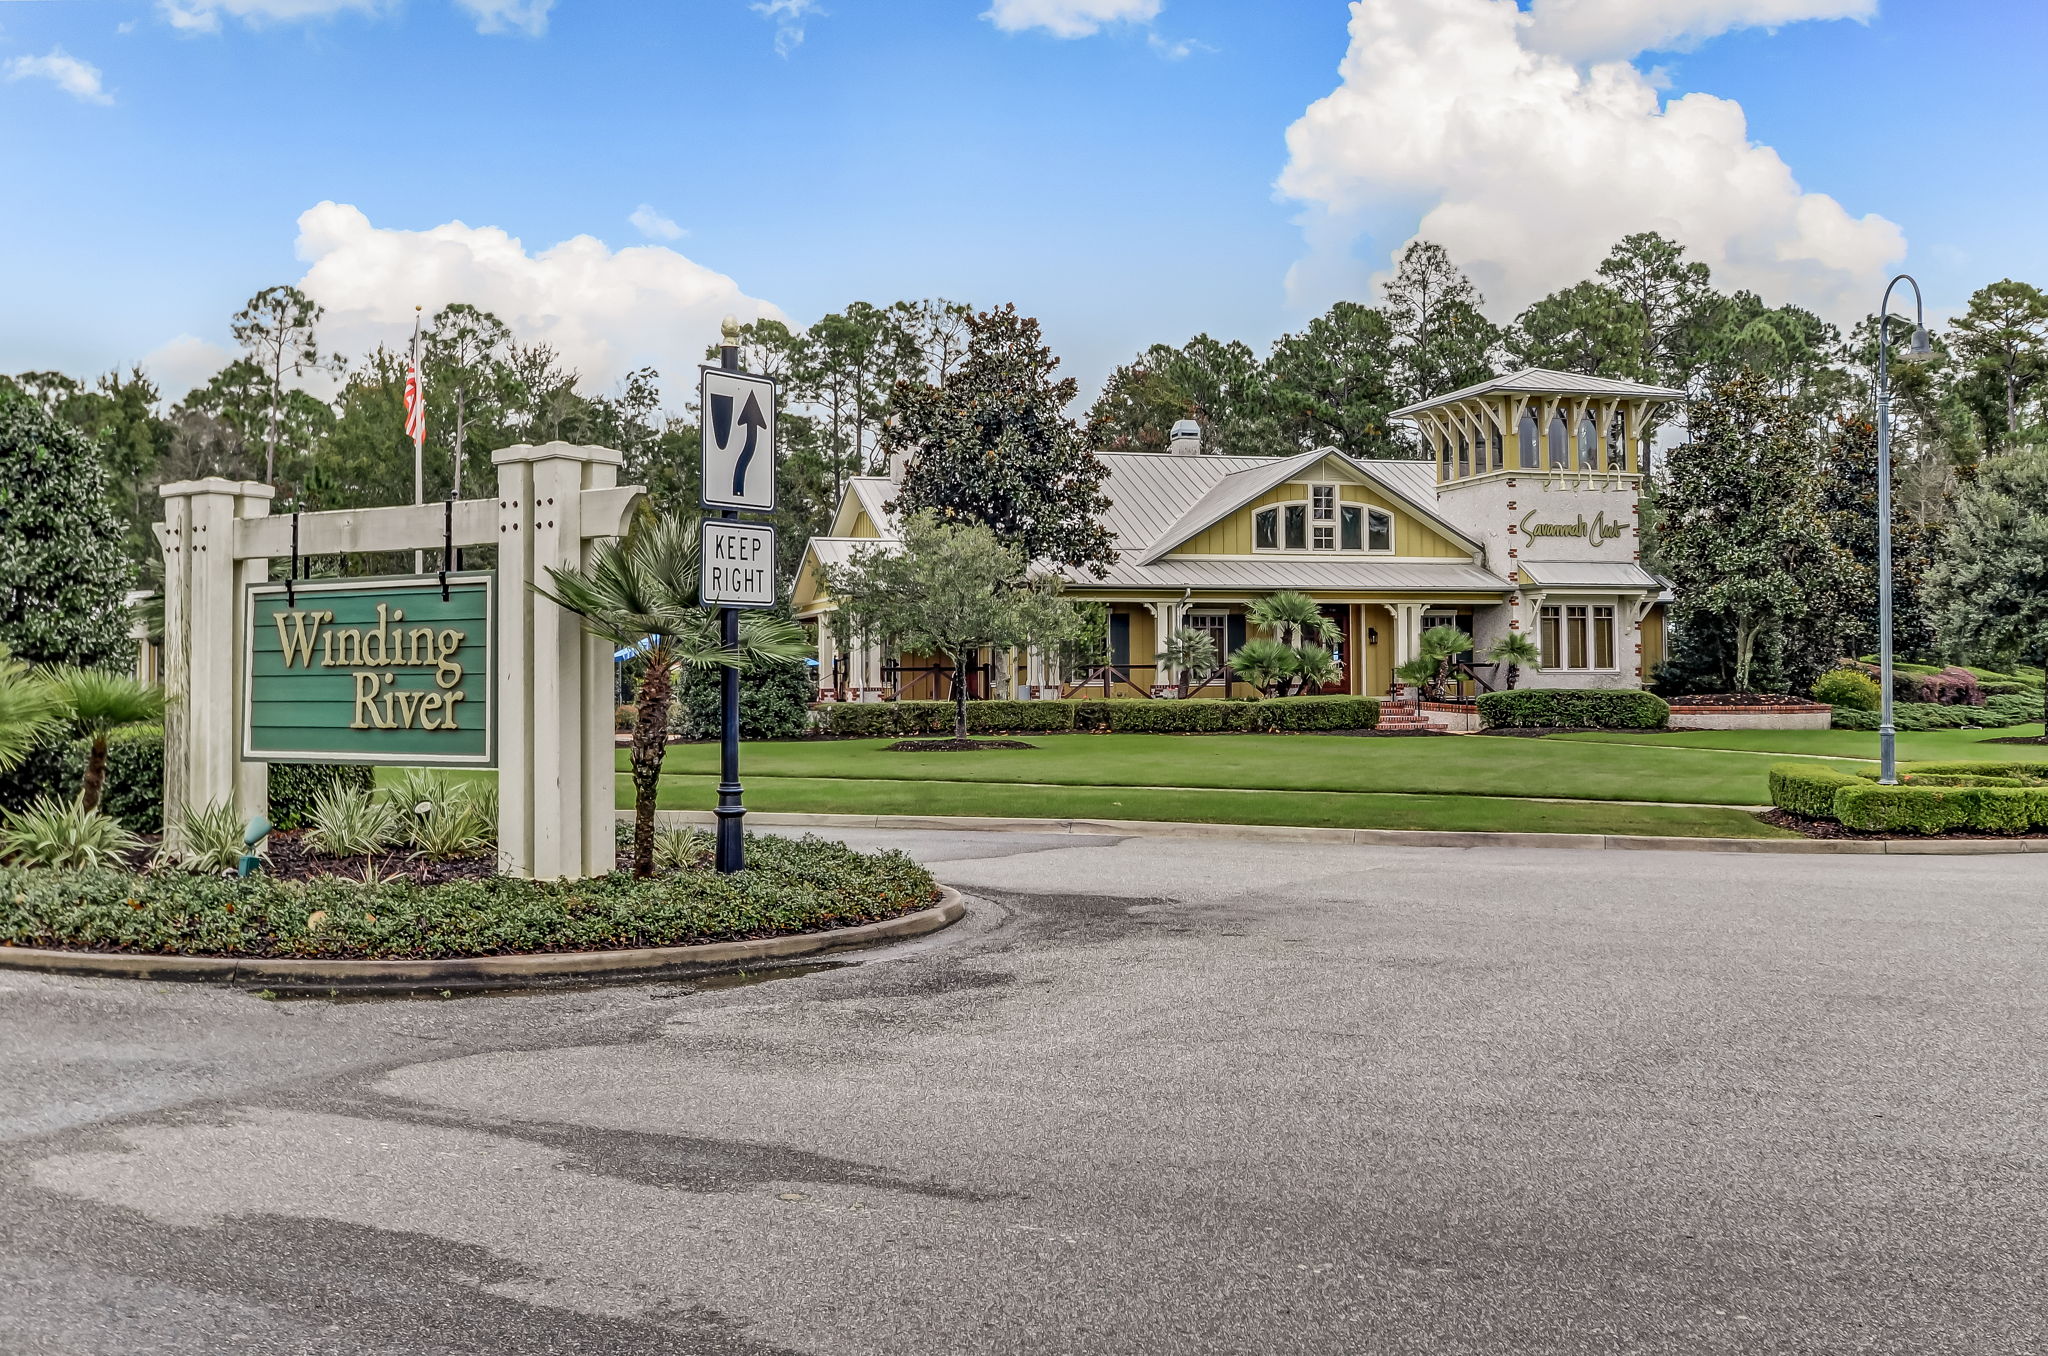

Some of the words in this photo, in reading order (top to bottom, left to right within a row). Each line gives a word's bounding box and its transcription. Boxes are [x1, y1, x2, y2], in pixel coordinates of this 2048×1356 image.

[715, 534, 761, 561] KEEP
[1520, 509, 1588, 548] Savannah
[712, 566, 764, 593] RIGHT
[273, 603, 465, 689] Winding
[350, 672, 465, 730] River
